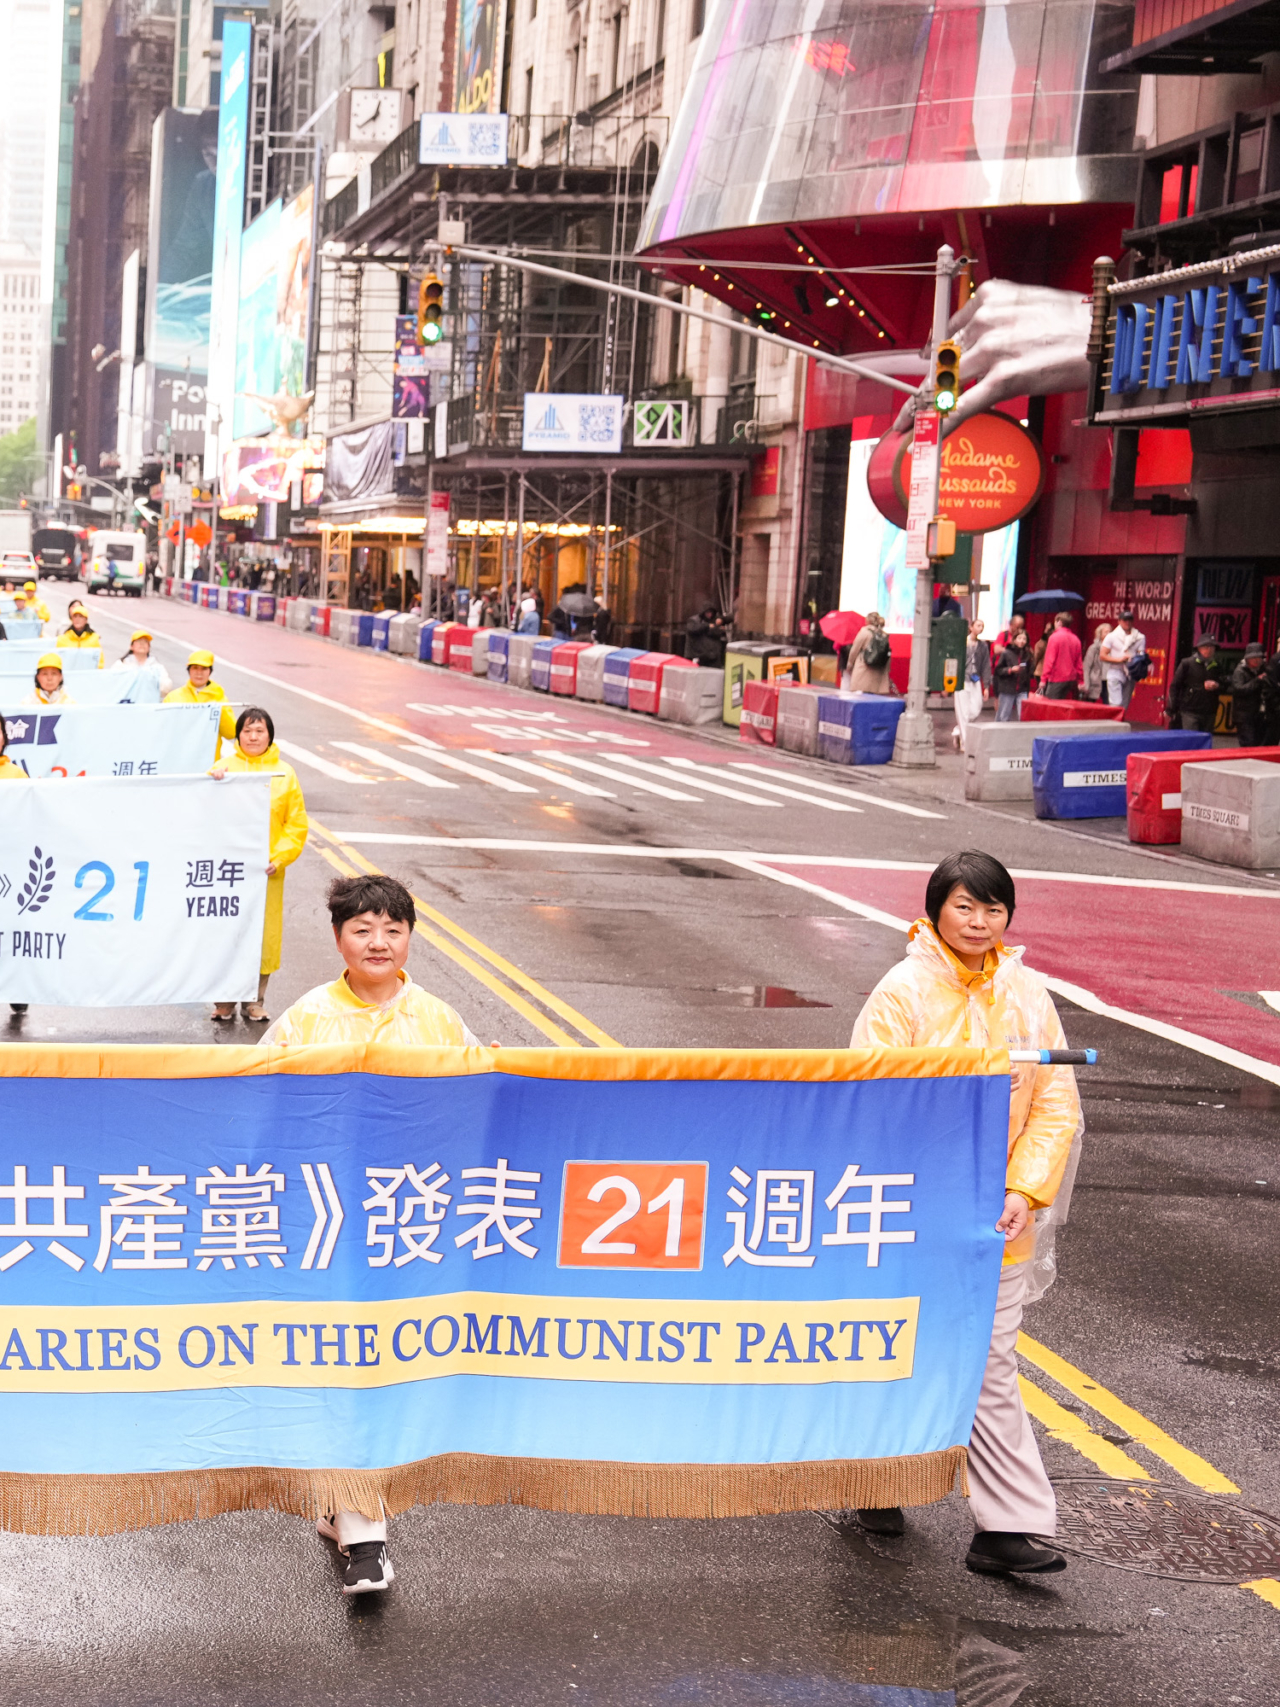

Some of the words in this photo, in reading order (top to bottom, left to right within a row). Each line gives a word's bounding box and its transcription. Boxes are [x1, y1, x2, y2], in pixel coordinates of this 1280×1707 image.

[1110, 272, 1280, 395] DINE
[172, 380, 209, 404] Po
[938, 498, 965, 508] NEW
[969, 498, 1002, 509] YORK
[1008, 759, 1032, 769] TIM
[1083, 773, 1127, 784] TIMES
[1190, 806, 1211, 821] TIMES
[186, 859, 245, 888] 週年
[74, 860, 150, 922] 21
[186, 896, 240, 917] YEARS
[13, 931, 66, 960] PARTY
[177, 1323, 259, 1368] ON
[272, 1321, 381, 1366] THE
[391, 1311, 720, 1364] COMMUNIST
[734, 1318, 908, 1363] PARTY
